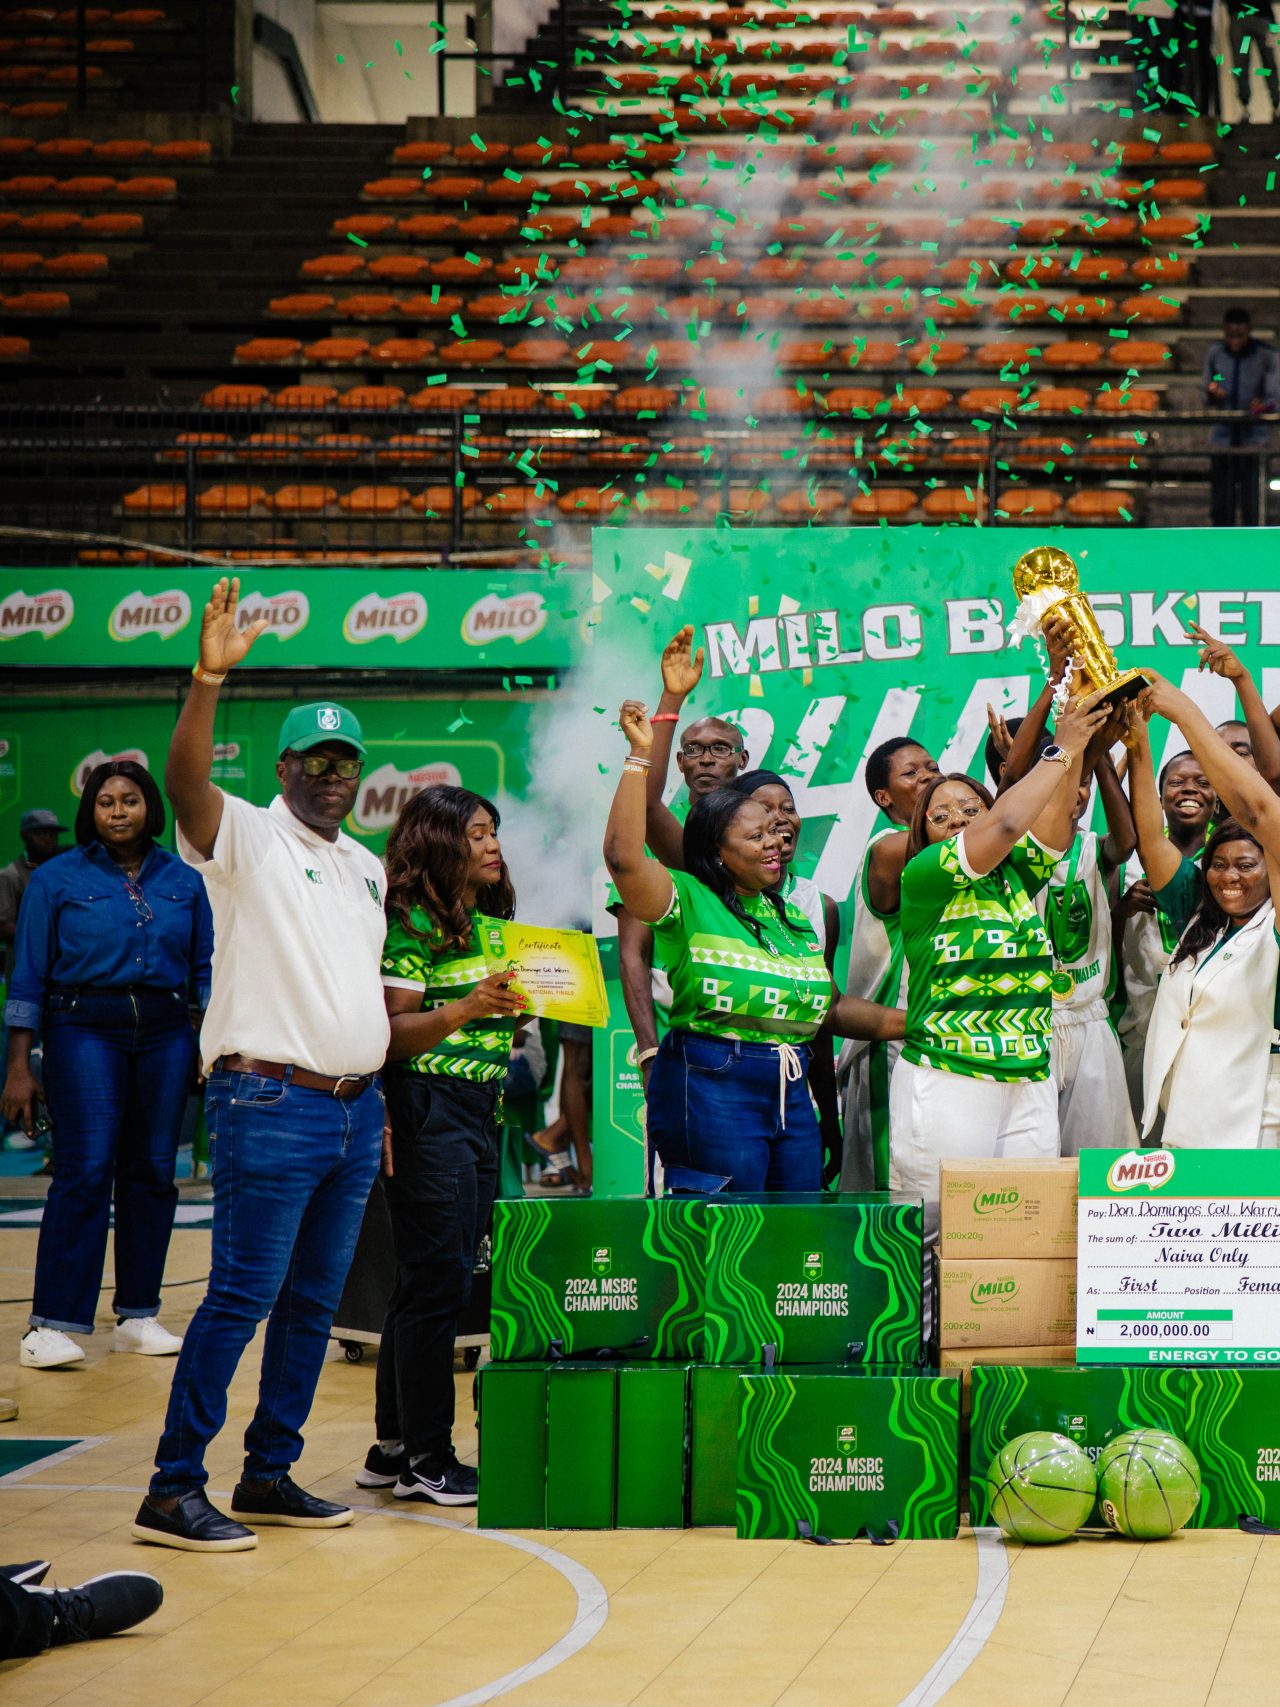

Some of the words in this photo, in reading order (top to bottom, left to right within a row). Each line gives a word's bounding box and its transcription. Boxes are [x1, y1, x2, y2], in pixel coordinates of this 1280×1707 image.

[1, 604, 65, 628] MILO
[119, 604, 182, 628] MILO
[355, 608, 418, 631] MILO
[473, 608, 537, 631] MILO
[704, 602, 924, 679] MILO
[519, 939, 562, 952] Certificate
[1117, 1162, 1169, 1182] MILO
[980, 1191, 1019, 1207] MILO
[1087, 1209, 1108, 1218] Pay:
[1108, 1202, 1134, 1217] Don
[1139, 1201, 1201, 1223] Domingos
[946, 1231, 984, 1241] 200x20g
[1088, 1235, 1103, 1243] The
[1126, 1234, 1138, 1244] of:
[1149, 1222, 1203, 1238] Two
[1154, 1247, 1204, 1263] Naira
[1209, 1247, 1249, 1268] Only
[565, 1278, 597, 1295] 2024
[601, 1278, 637, 1294] MSBC
[776, 1284, 809, 1300] 2024
[812, 1283, 848, 1300] MSBC
[977, 1281, 1016, 1296] MILO
[1086, 1287, 1101, 1295] As:
[1118, 1276, 1159, 1292] First
[1184, 1286, 1220, 1295] Position
[564, 1295, 639, 1312] CHAMPIONS
[775, 1300, 849, 1317] CHAMPIONS
[1146, 1311, 1184, 1320] AMOUNT
[943, 1322, 981, 1331] 200x20g
[1120, 1324, 1210, 1339] 2,000,000.00
[1149, 1350, 1219, 1361] ENERGY
[1224, 1350, 1248, 1361] TO
[1253, 1350, 1280, 1361] GO
[810, 1458, 843, 1475] 2024
[847, 1458, 884, 1474] MSBC
[809, 1475, 885, 1492] CHAMPIONS
